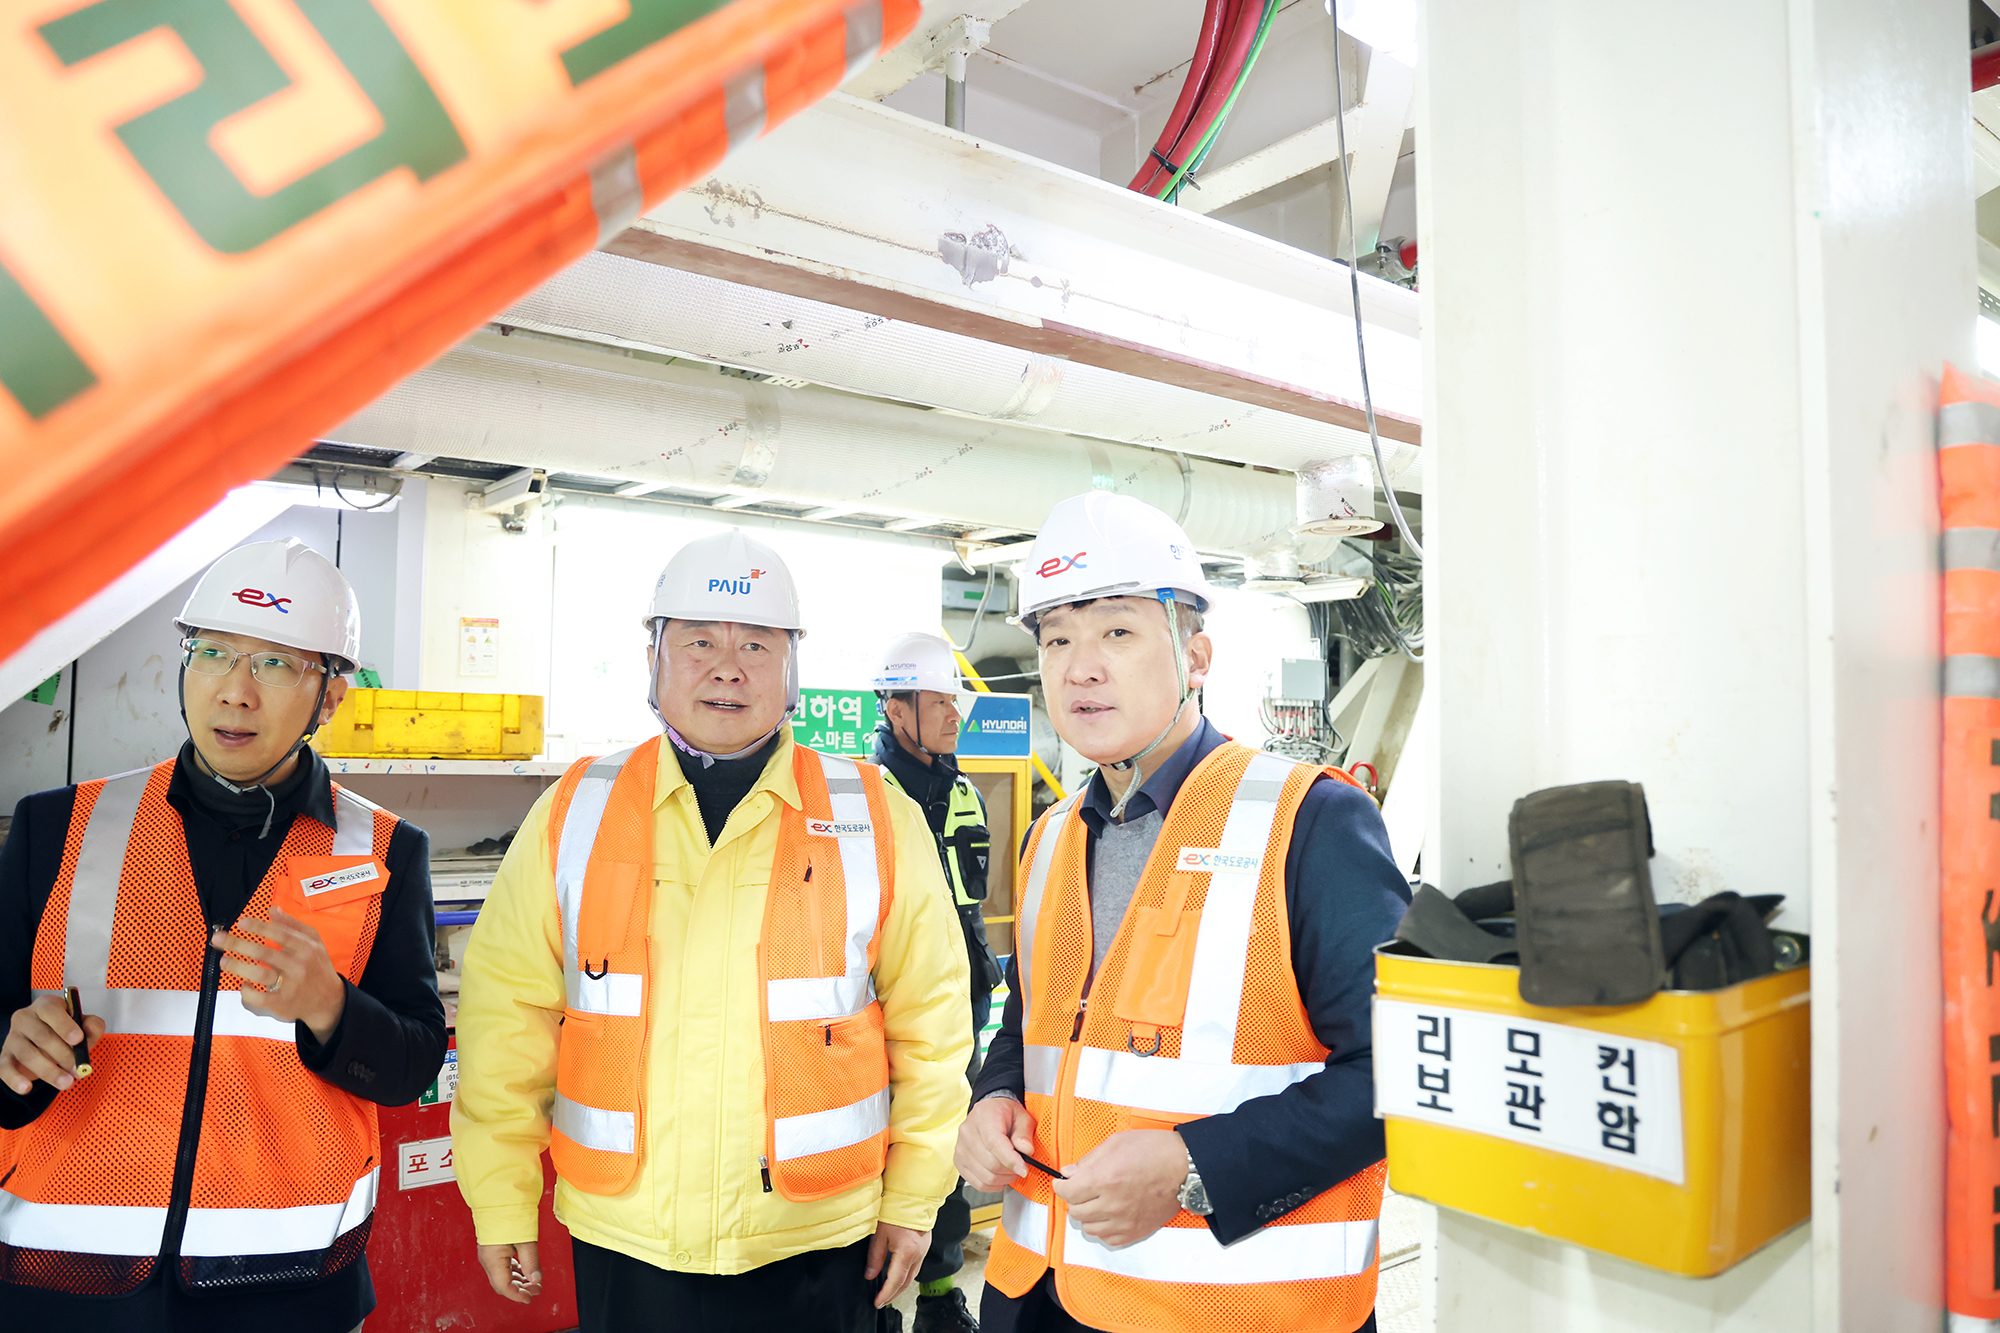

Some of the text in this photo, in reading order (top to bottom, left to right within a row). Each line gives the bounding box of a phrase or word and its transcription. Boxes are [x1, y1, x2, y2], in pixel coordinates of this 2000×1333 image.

[1036, 551, 1087, 578] ex
[232, 588, 292, 614] ex
[981, 716, 1027, 730] HYUNDAI
[808, 730, 858, 750] 스마트
[811, 823, 832, 833] ex
[1183, 853, 1259, 869] ex 한국도로공사
[309, 876, 337, 889] ex
